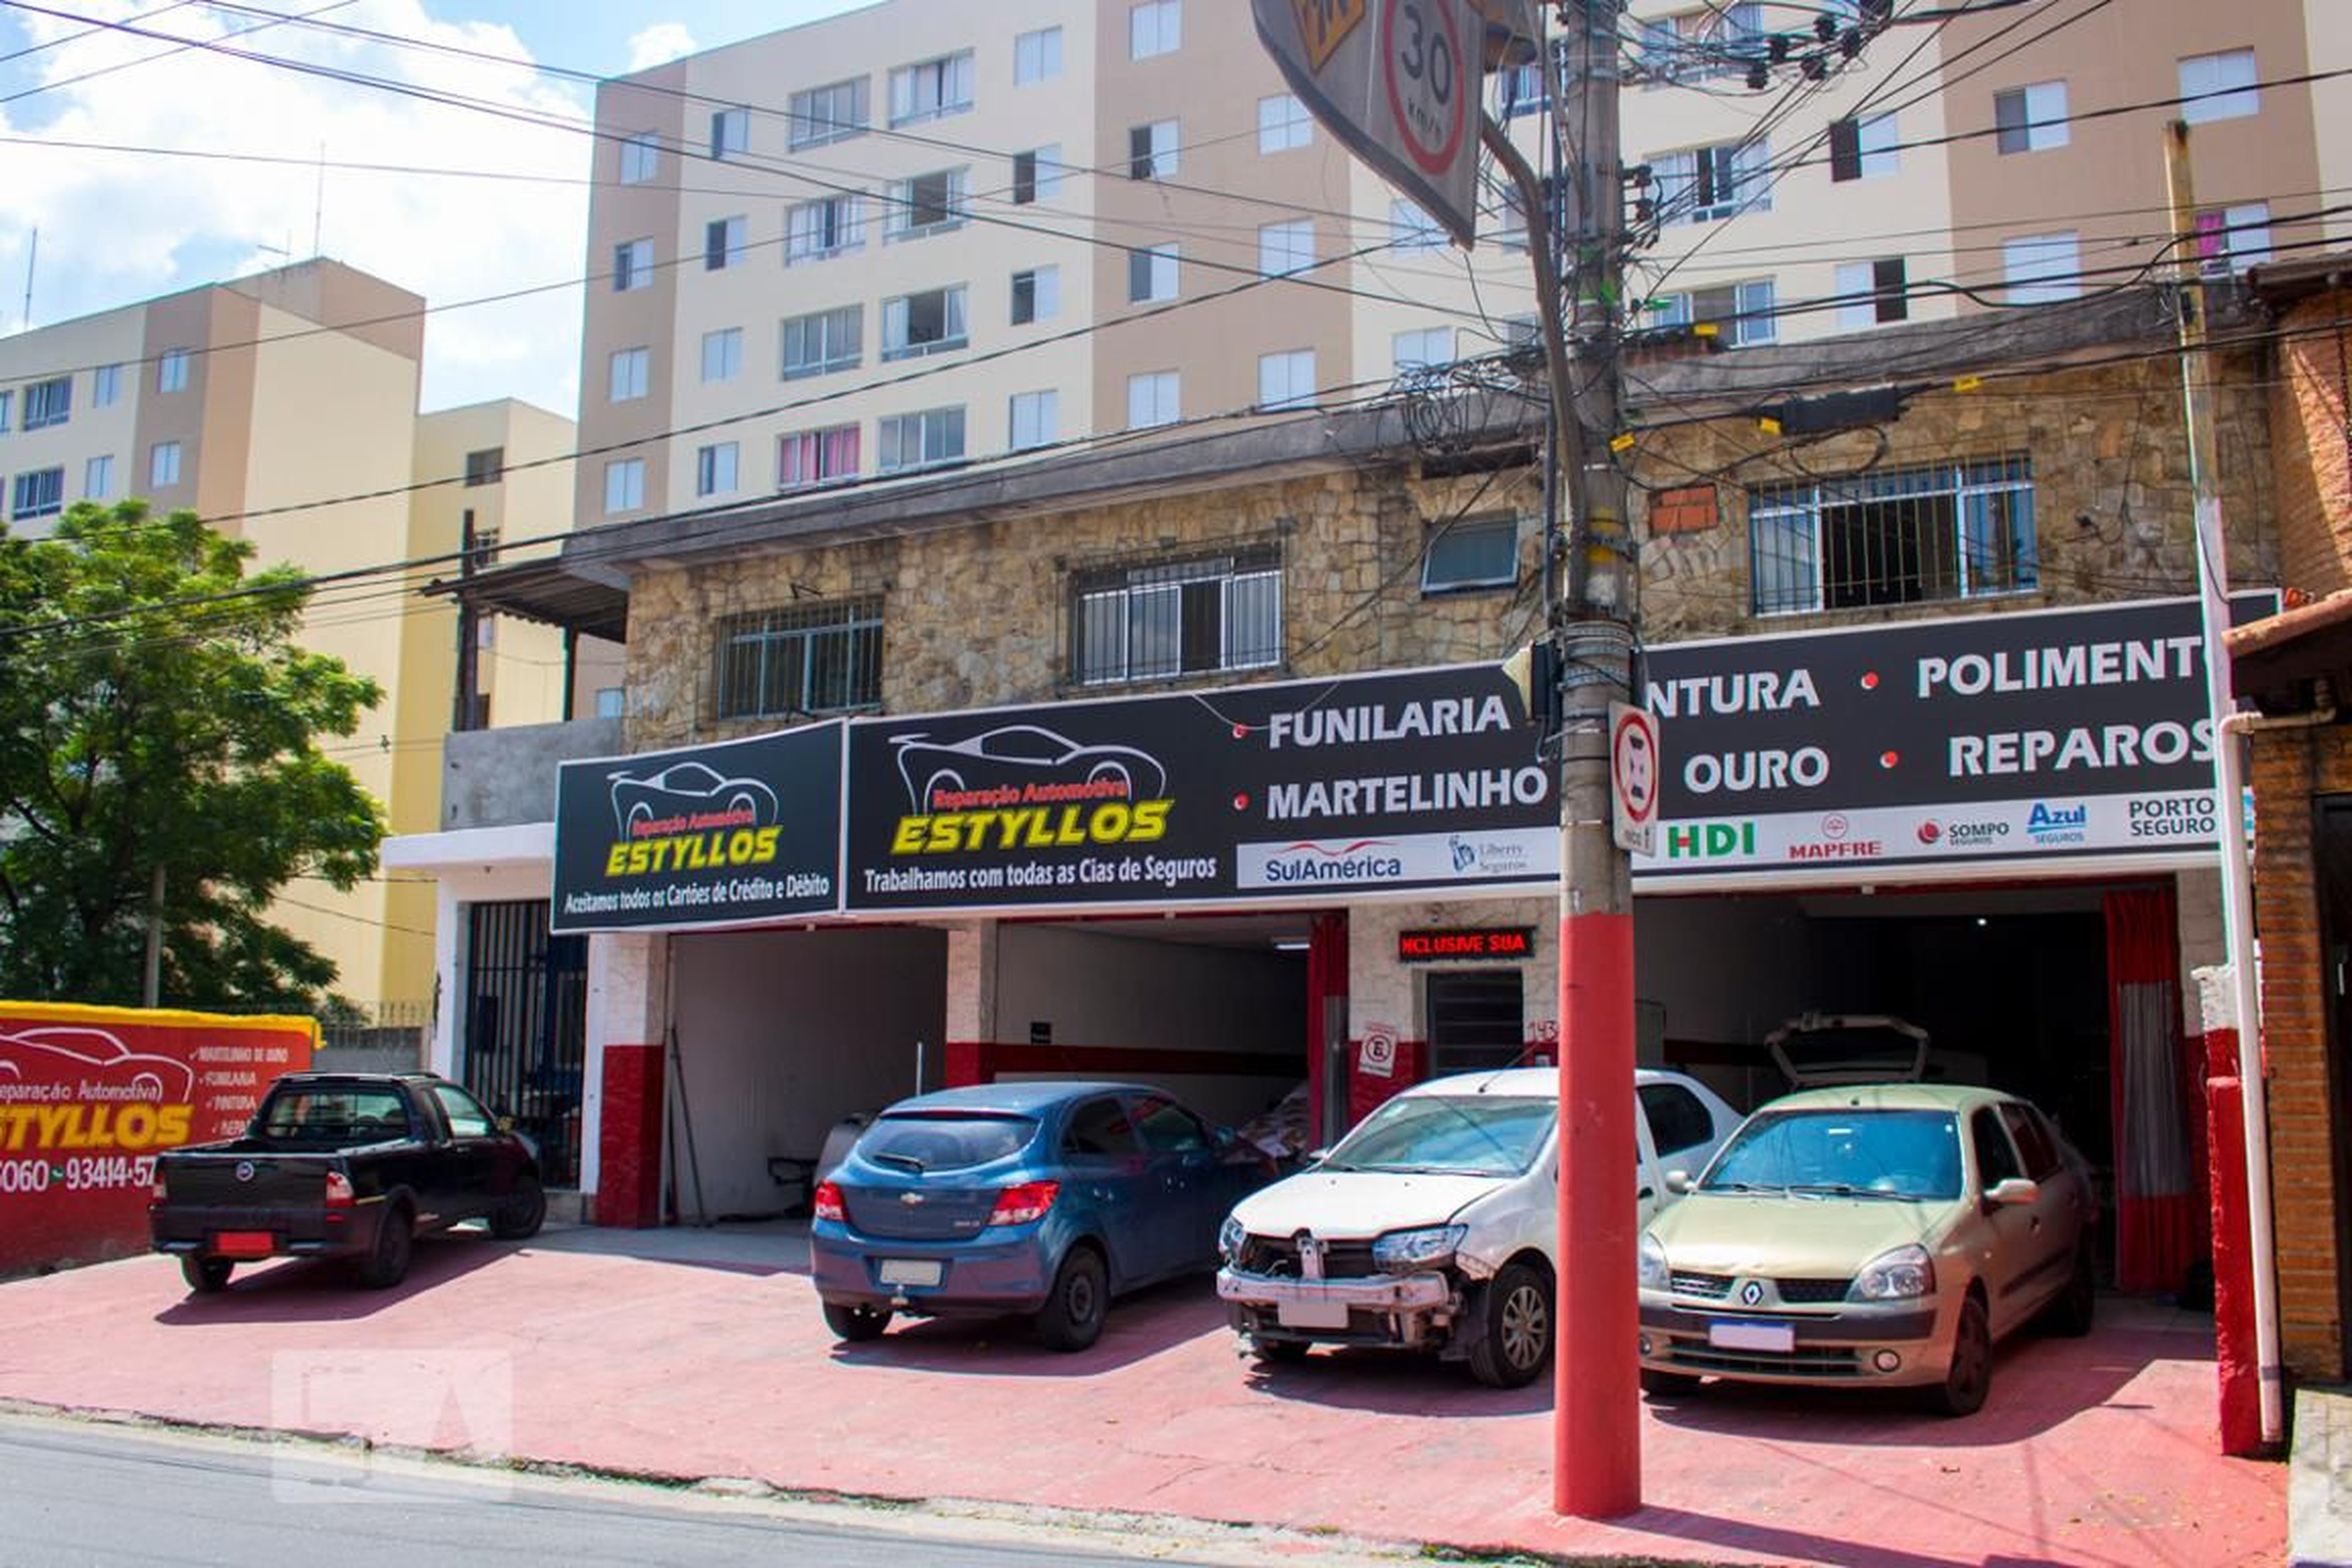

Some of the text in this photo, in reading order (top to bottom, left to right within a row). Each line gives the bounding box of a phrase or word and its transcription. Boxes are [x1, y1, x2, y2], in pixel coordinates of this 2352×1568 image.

[1401, 4, 1452, 107] 30
[1918, 636, 2206, 698] POLIMENT
[1645, 669, 1821, 718] NTURA
[1268, 695, 1512, 749] FUNILARIA
[1949, 719, 2215, 777] REPAROS
[1022, 776, 1128, 802] Automotiva
[1684, 746, 1830, 794] OURO
[1267, 766, 1548, 820] MARTELINHO
[2128, 797, 2215, 818] PORTO
[891, 799, 1175, 856] ESTYLLOS
[1948, 822, 2010, 839] SOMPO
[2027, 802, 2086, 826] Azul
[2130, 816, 2216, 837] SEGURO
[604, 825, 784, 876] ESTYLLOS
[1667, 821, 1755, 858] HDI
[1789, 840, 1882, 859] MAPFRE
[564, 873, 830, 914] Aceitamos todos os Cartões de Crédito e Débito
[864, 855, 1216, 894] Trabalhamos com todas as Cias de Seguros
[1489, 933, 1525, 952] SUA
[0, 1081, 72, 1103] eparação
[0, 1102, 195, 1152] TYLLOS
[0, 1159, 49, 1193] 060
